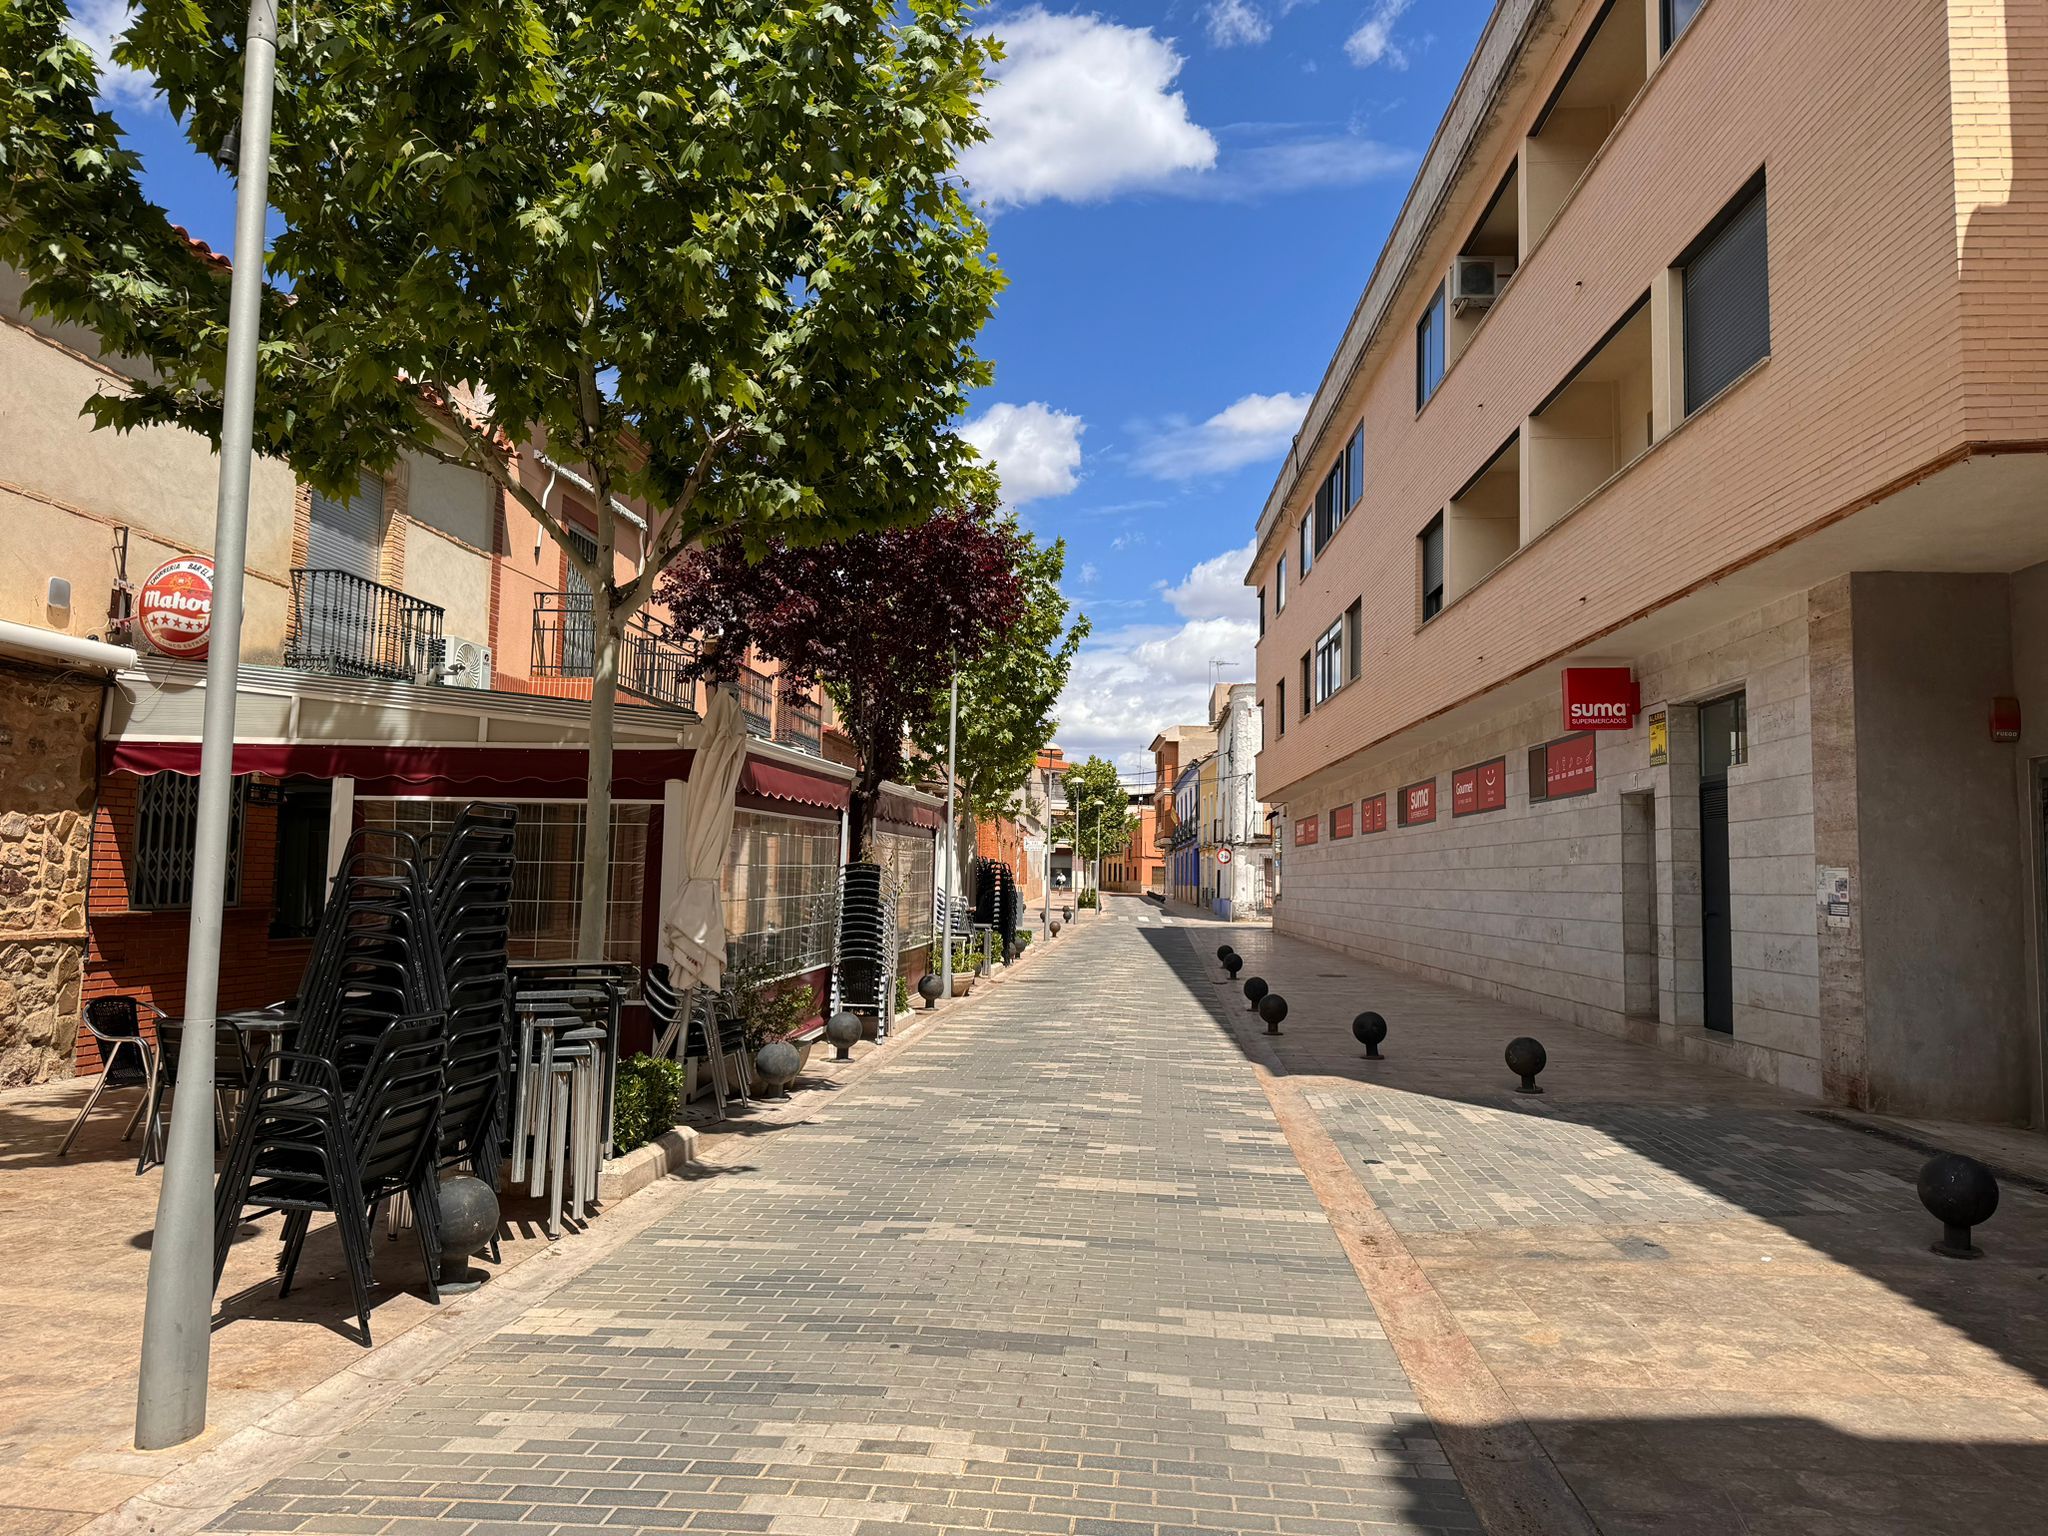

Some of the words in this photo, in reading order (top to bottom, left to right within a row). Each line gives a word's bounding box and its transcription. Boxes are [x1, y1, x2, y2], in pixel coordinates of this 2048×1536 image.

[187, 563, 202, 571] BAR
[200, 568, 209, 576] EL
[183, 634, 210, 648] ESTRELL
[1571, 702, 1627, 717] suma
[1456, 781, 1473, 795] Gourmet
[1411, 788, 1429, 809] suma
